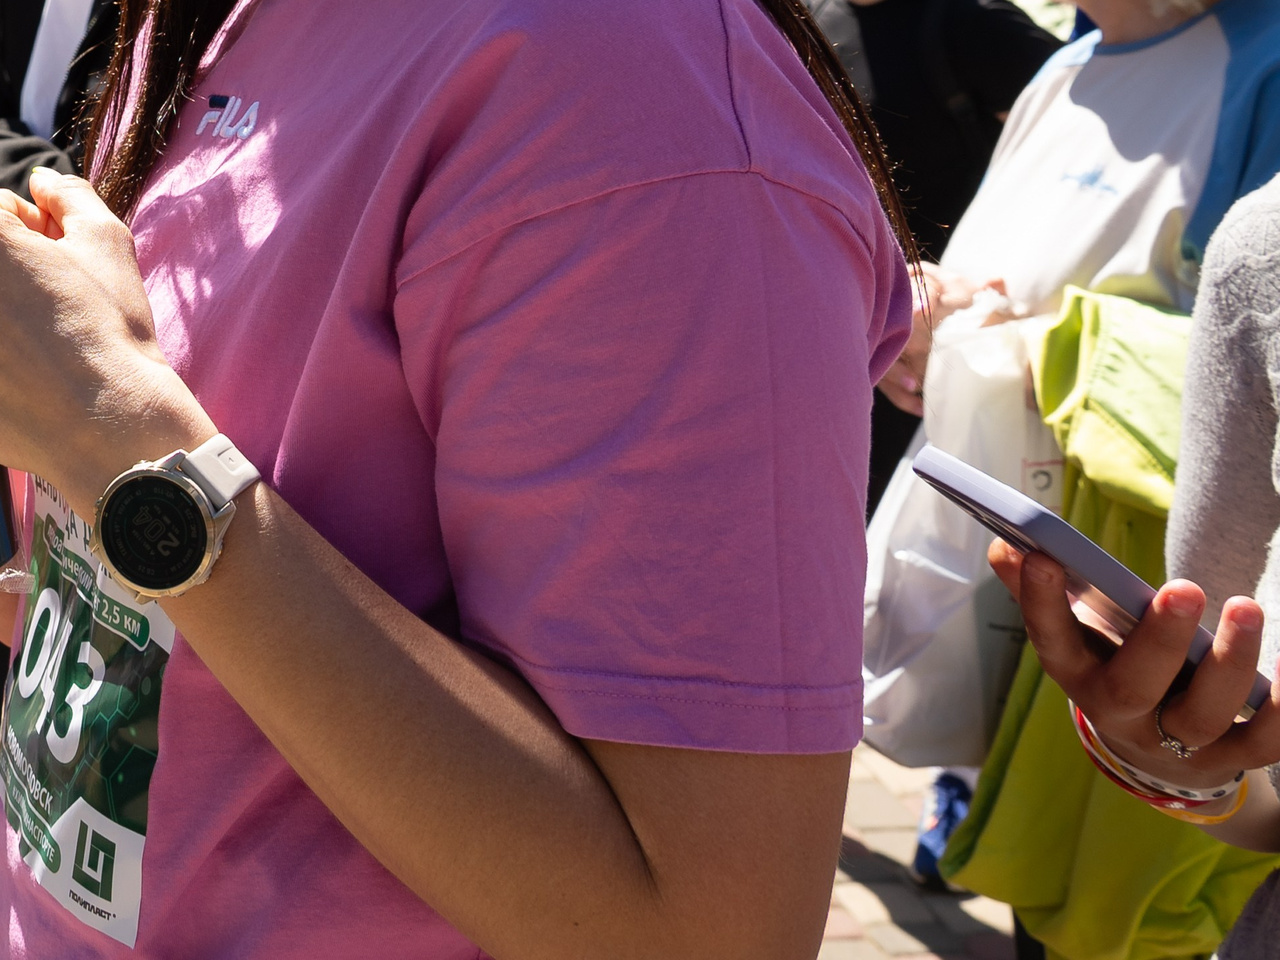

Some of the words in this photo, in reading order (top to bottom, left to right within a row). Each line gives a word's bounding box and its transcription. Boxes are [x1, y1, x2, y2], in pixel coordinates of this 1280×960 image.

[195, 94, 260, 140] FILA
[102, 599, 120, 625] 2,5
[68, 888, 112, 921] ПОЛИПЛАСТ
